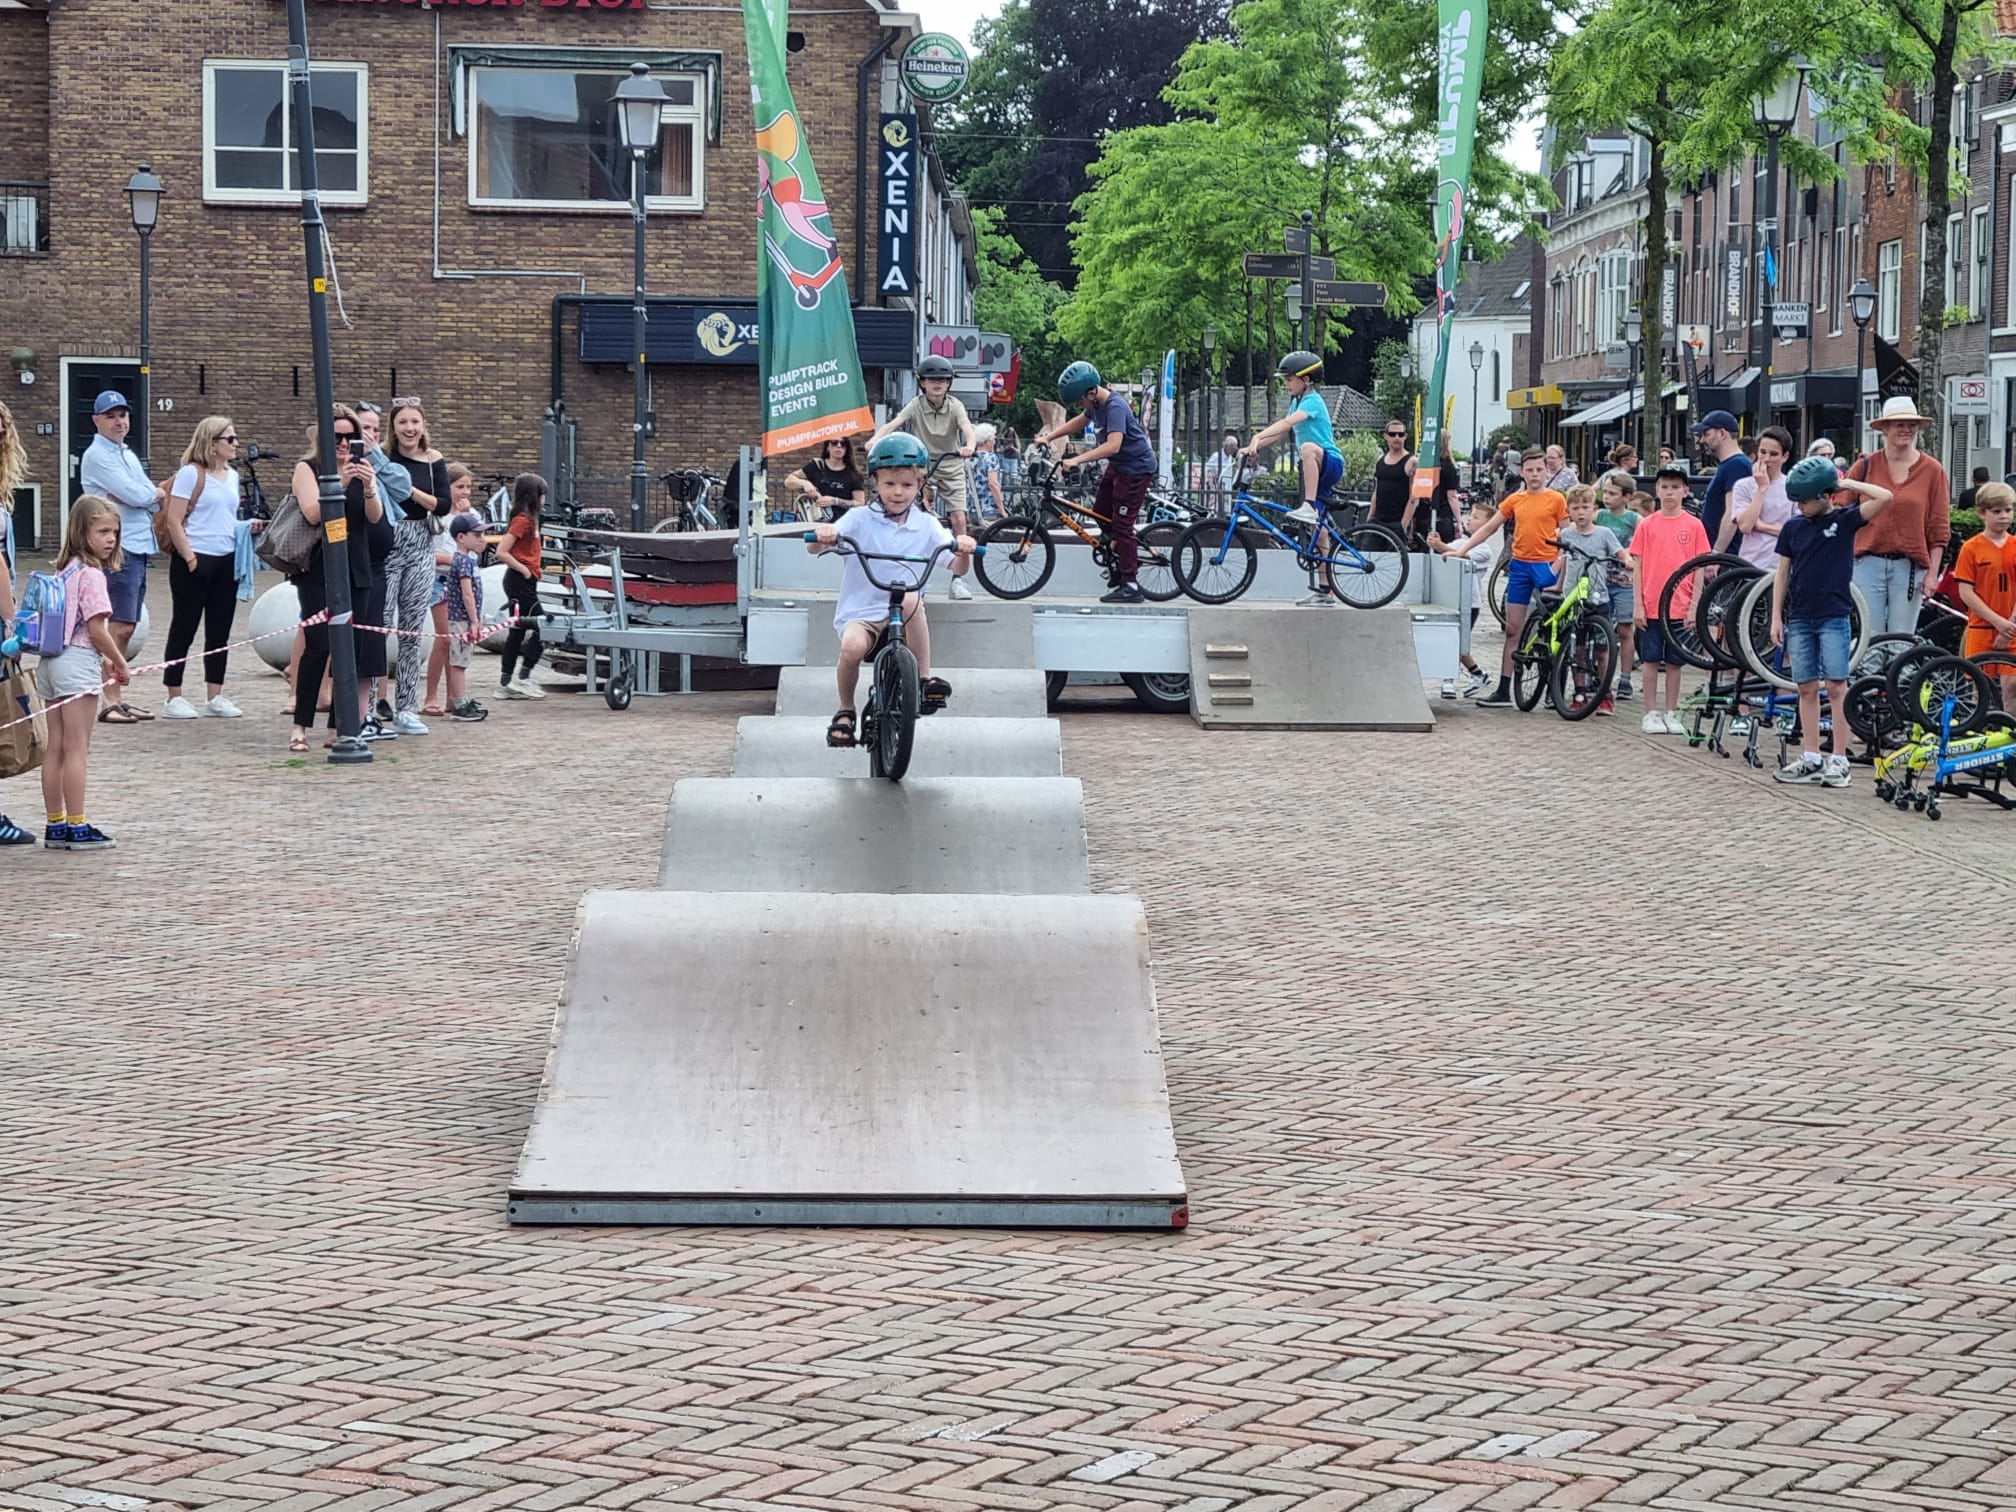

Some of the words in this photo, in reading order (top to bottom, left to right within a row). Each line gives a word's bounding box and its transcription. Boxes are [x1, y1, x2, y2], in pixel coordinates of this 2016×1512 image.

[908, 60, 962, 74] Heineken
[882, 151, 909, 291] XENIA
[1727, 250, 1741, 317] BRANDHOF
[1662, 268, 1675, 329] BRANDHOF
[1775, 313, 1805, 321] MARKT
[768, 359, 838, 388] PUMPTRACK
[769, 380, 814, 403] DESIGN
[815, 372, 848, 391] BUILD
[157, 398, 173, 411] 19
[771, 395, 817, 417] EVENTS
[776, 420, 859, 449] PUMPFACTORY.NL
[1955, 752, 2004, 771] STRIDER
